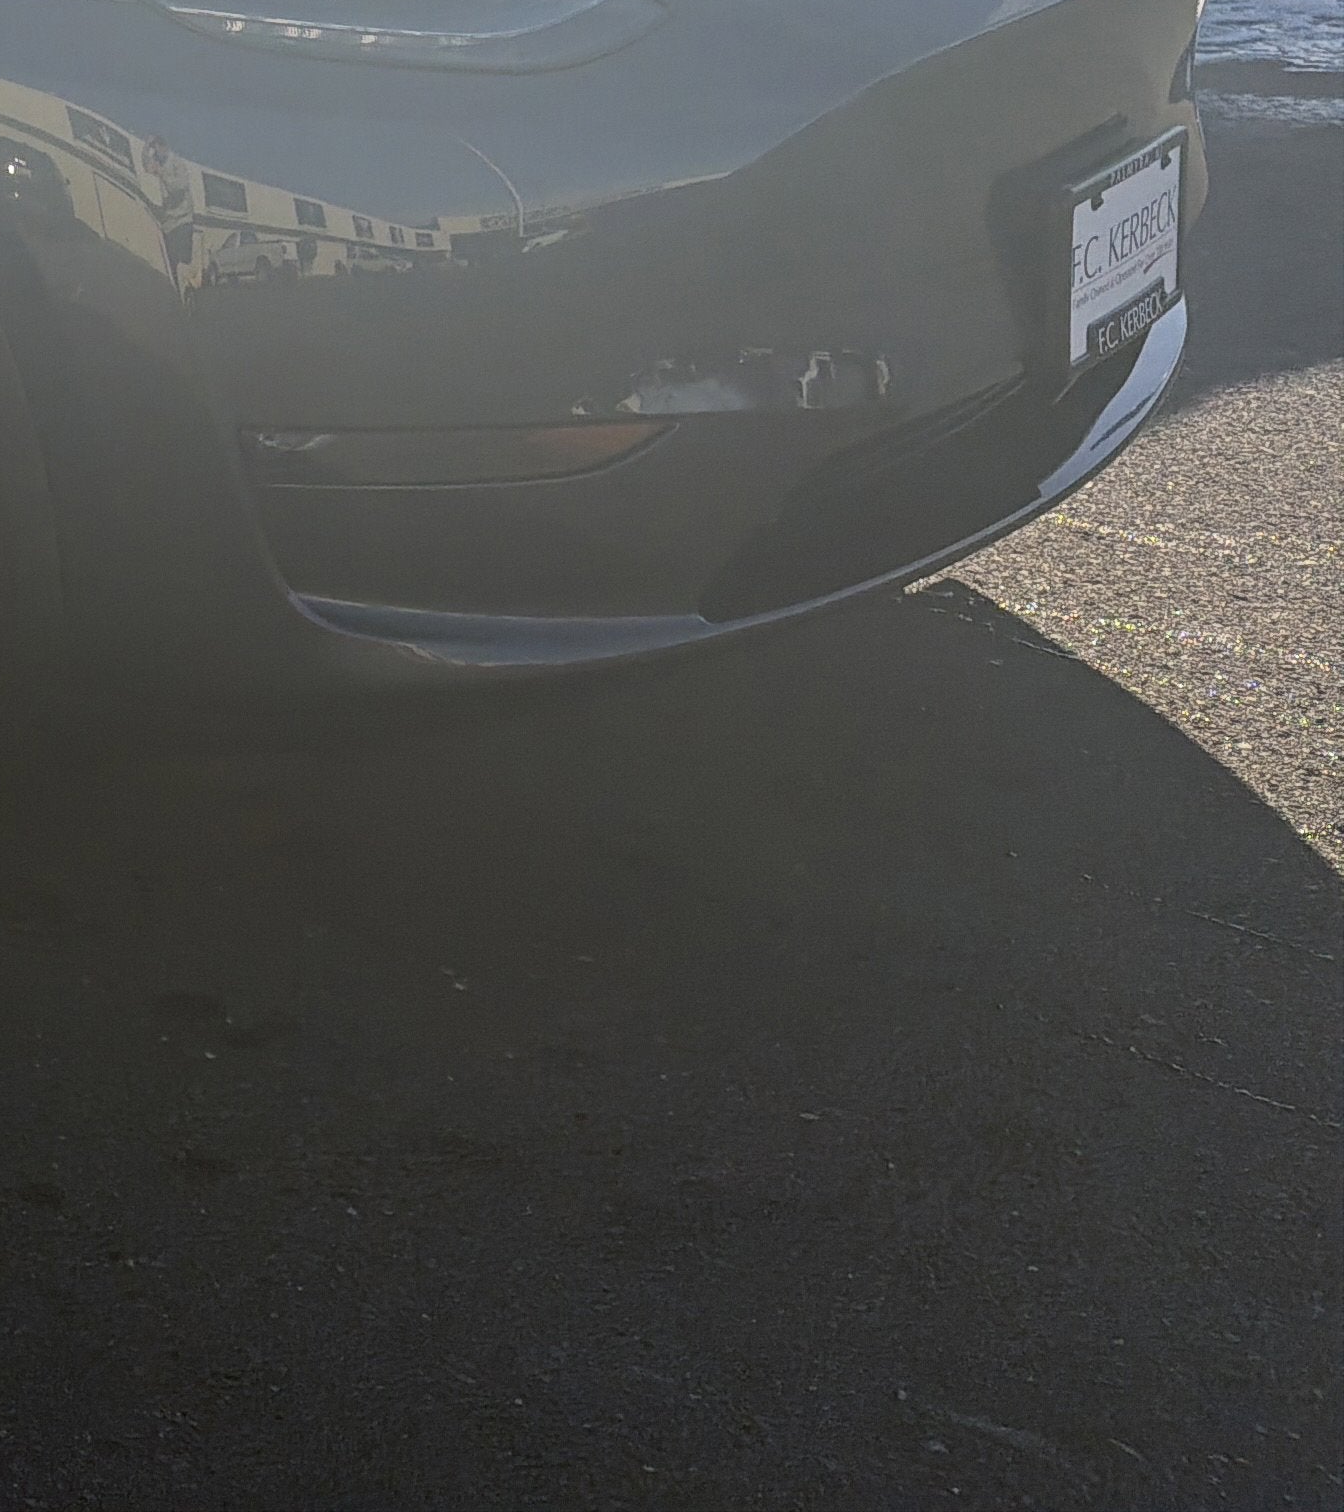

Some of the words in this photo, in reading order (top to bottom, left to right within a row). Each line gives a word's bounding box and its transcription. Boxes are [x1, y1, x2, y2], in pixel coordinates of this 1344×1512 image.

[1072, 235, 1103, 288] F.C.
[1108, 184, 1178, 268] KERBECK
[1097, 320, 1119, 355] F.C.
[1119, 287, 1164, 342] KERBECK
